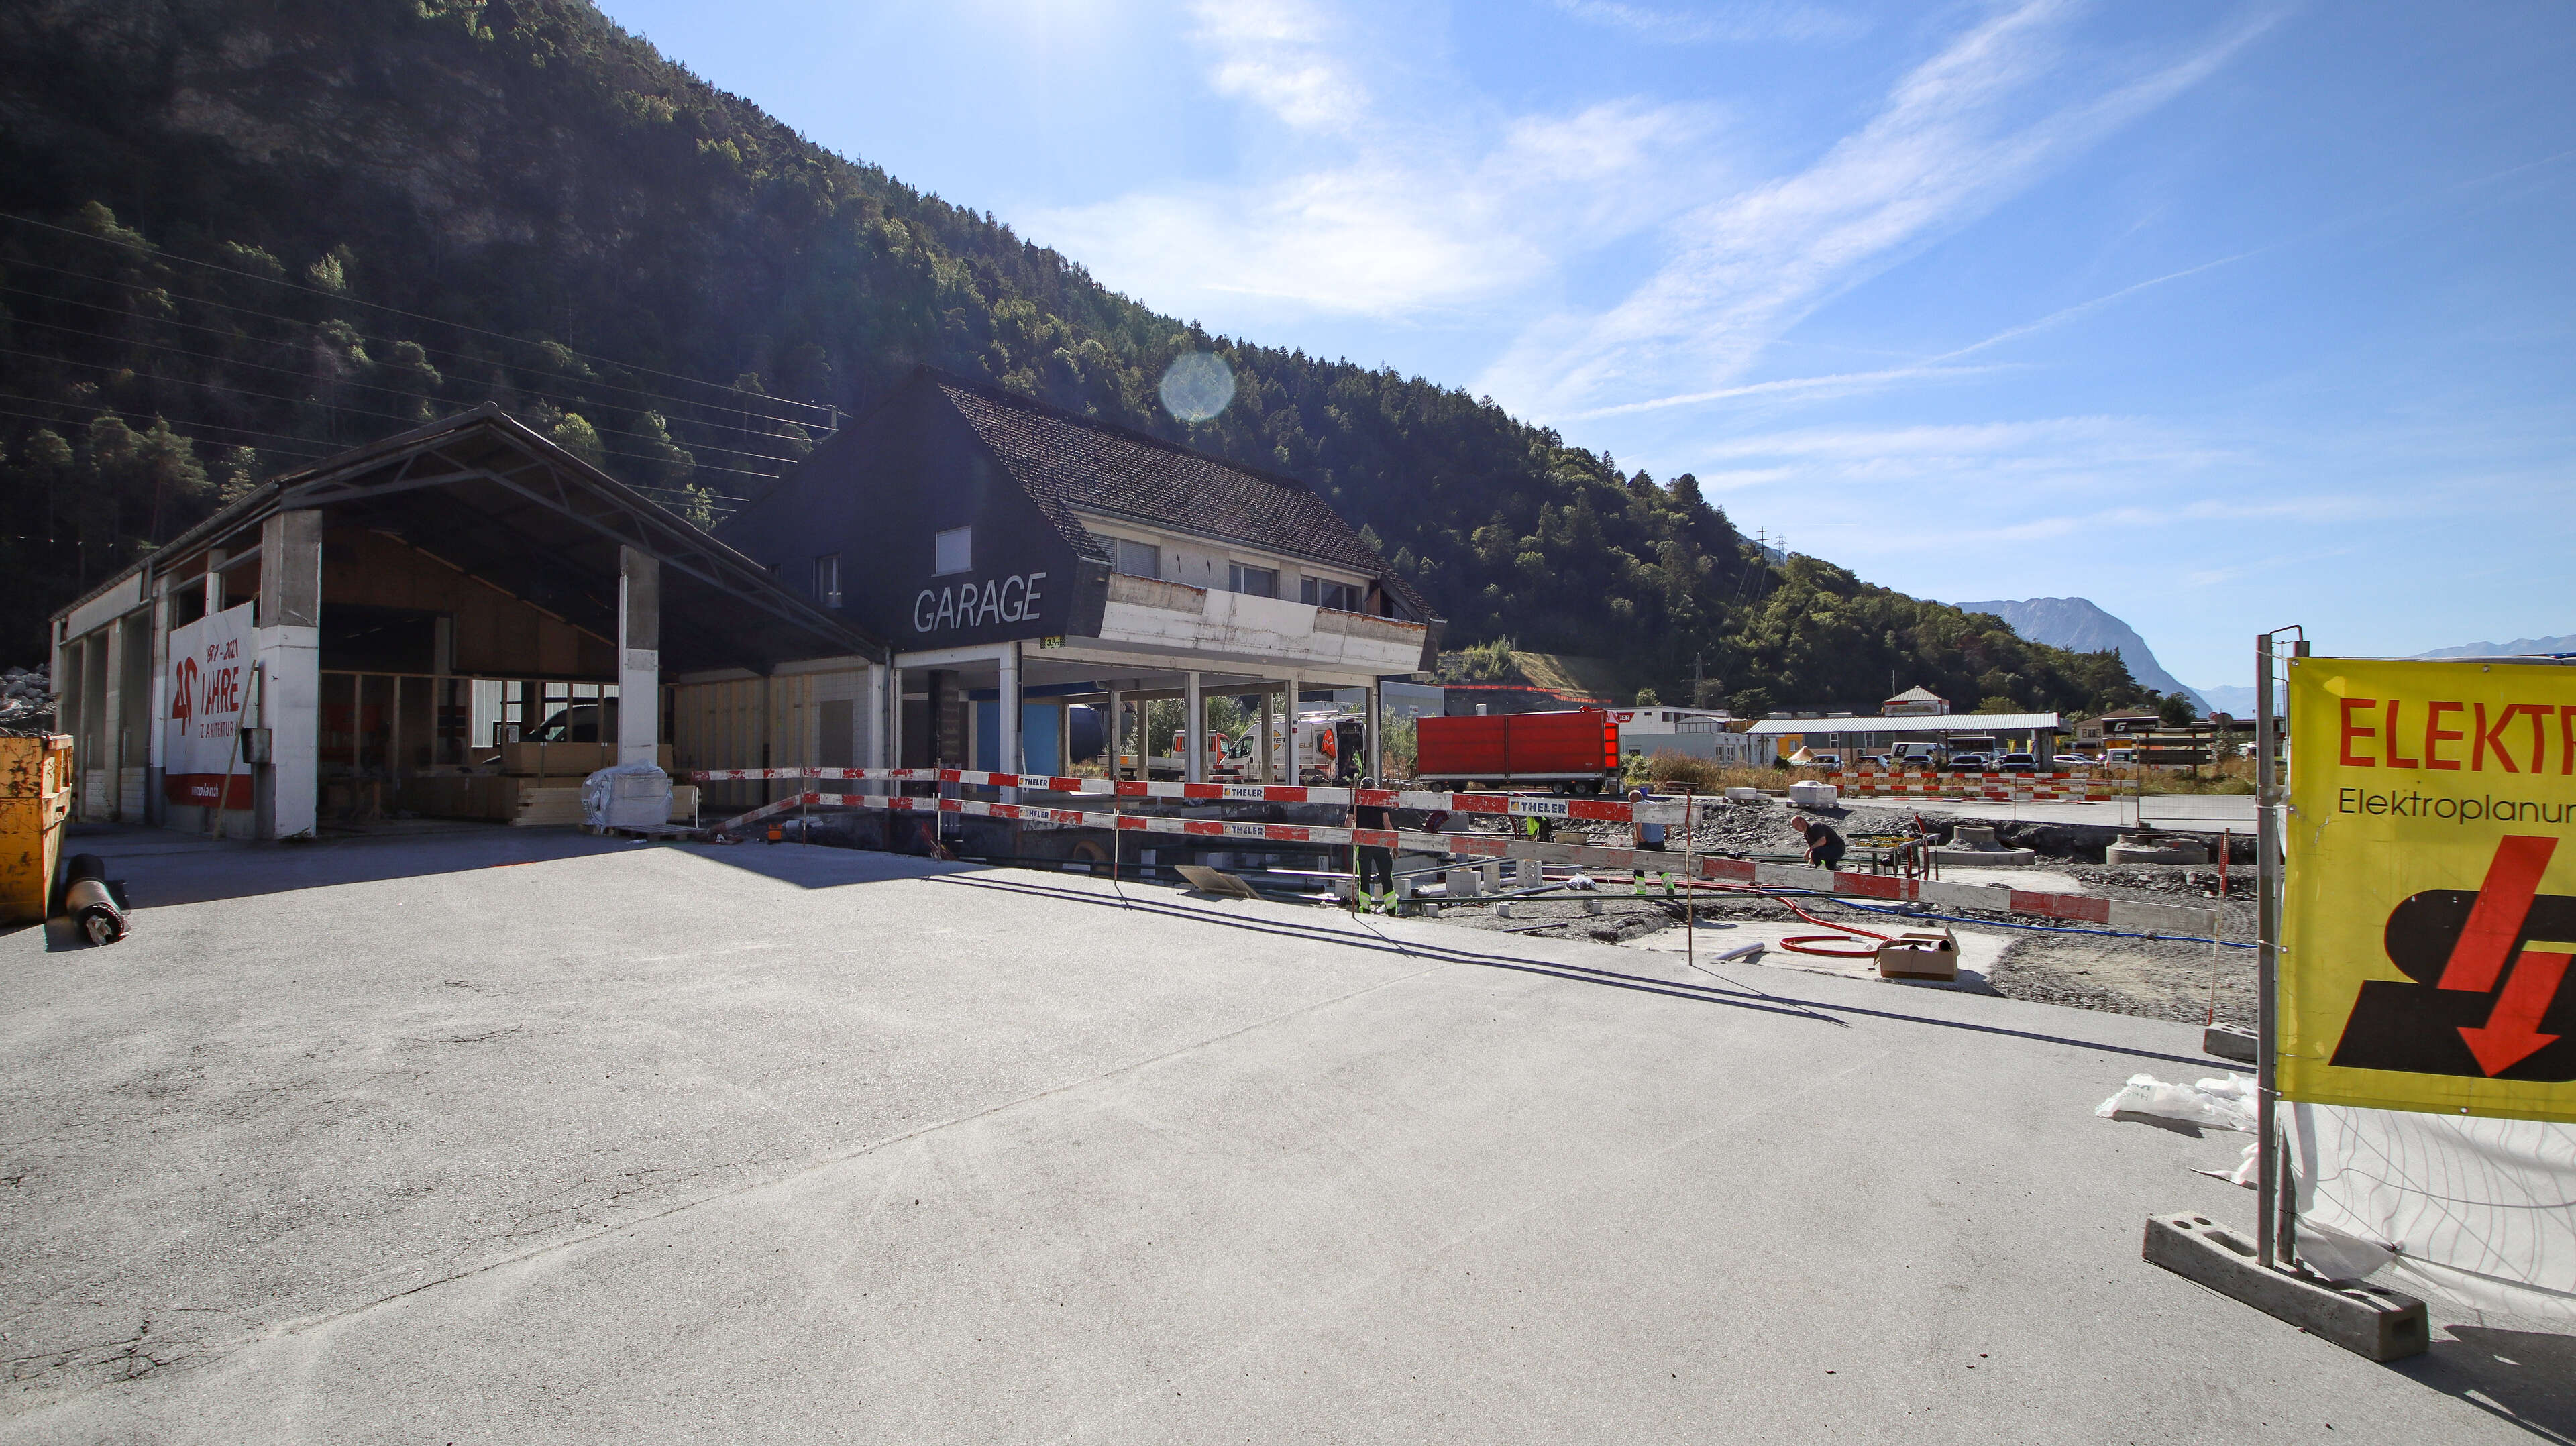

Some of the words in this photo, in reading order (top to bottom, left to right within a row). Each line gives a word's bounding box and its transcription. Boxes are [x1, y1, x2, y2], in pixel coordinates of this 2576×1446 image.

[914, 572, 1046, 632] GARAGE
[1024, 778, 1048, 787] THELER
[1232, 788, 1263, 797] THELER
[1521, 801, 1566, 814] THELER
[1026, 809, 1049, 819] HELER
